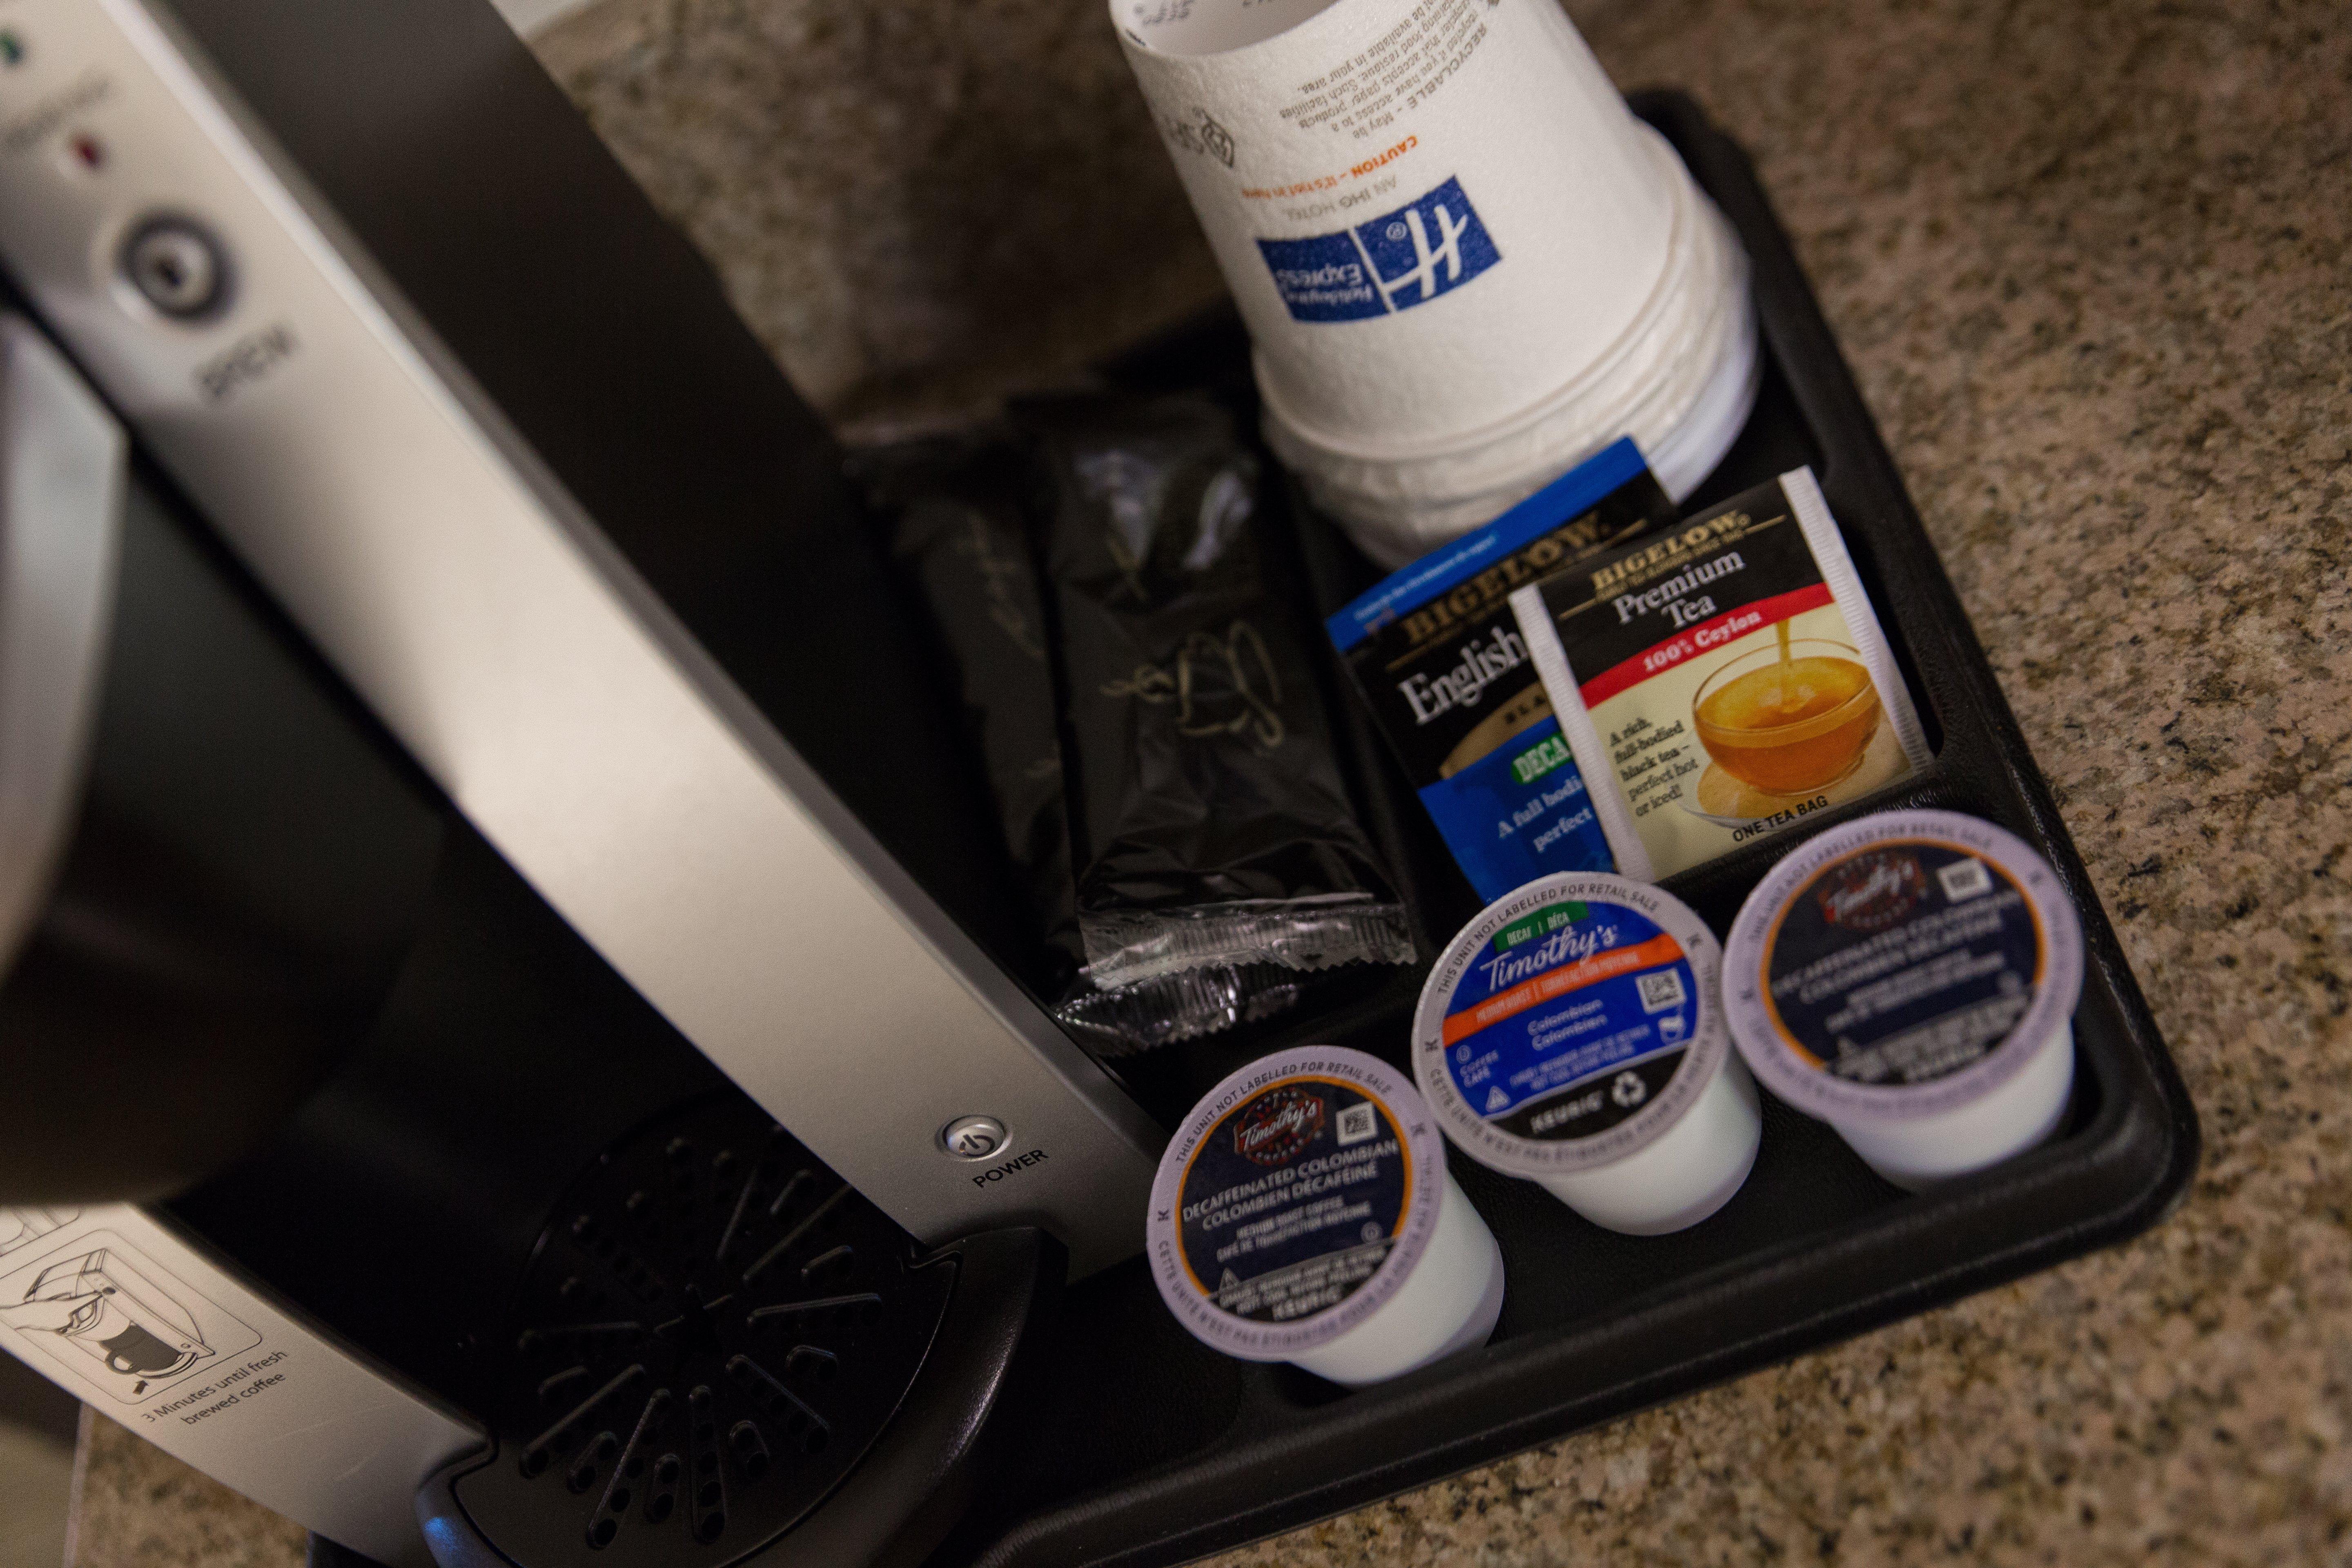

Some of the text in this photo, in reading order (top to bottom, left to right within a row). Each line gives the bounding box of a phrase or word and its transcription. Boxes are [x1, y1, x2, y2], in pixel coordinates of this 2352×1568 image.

[1412, 6, 1425, 20] be
[1368, 18, 1412, 58] available
[1329, 60, 1354, 82] your
[1355, 53, 1367, 66] in
[1407, 22, 1488, 109] RECYCLABLE
[1297, 77, 1327, 94] area.
[1329, 79, 1358, 100] Such
[1395, 74, 1421, 96] have
[1298, 100, 1347, 128] products
[1331, 122, 1339, 132] a
[1342, 115, 1355, 128] to
[1355, 94, 1394, 120] access
[1369, 111, 1394, 130] May
[1352, 126, 1369, 138] be
[1350, 135, 1418, 178] CAUTION
[1340, 187, 1371, 208] IHG
[1276, 262, 1363, 289] Express
[1592, 510, 1738, 590] BIGELOW
[1401, 510, 1599, 644] BIGELOW
[1613, 552, 1746, 624] Premium
[1661, 596, 1716, 628] Tea
[1644, 612, 1762, 672] 100% Ceylon
[1397, 626, 1528, 726] English
[1512, 736, 1571, 783] DECA
[1610, 732, 1621, 747] A
[1615, 719, 1685, 764] full-bodied
[1619, 757, 1657, 782] black
[1658, 748, 1681, 763] tea
[1628, 758, 1698, 802] perfect hot
[1499, 775, 1584, 838] A full bodi
[1635, 802, 1649, 816] or
[1733, 795, 1828, 841] ONE TEA BAG
[1533, 808, 1592, 853] perfect
[1437, 883, 1659, 993] THIS UNIT NOT LABELLED FOR RETAIL SALE
[1507, 926, 1532, 946] DECAF
[1479, 924, 1613, 991] Timothy's
[1528, 999, 1604, 1036] Colombian
[1532, 1014, 1608, 1051] Colombien
[1176, 1137, 1195, 1162] THIS
[1194, 1111, 1216, 1136] UNIT
[1217, 1092, 1239, 1113] NOT
[1240, 1064, 1297, 1094] LABELLED
[1301, 1062, 1323, 1073] FOR
[1327, 1062, 1363, 1080] RETAIL
[1240, 1100, 1316, 1152] Timothy's
[1530, 1091, 1603, 1134] KEURIG
[972, 1149, 1049, 1188] POWER
[1183, 1167, 1296, 1223] DECAFFEINATED
[1298, 1139, 1399, 1179] COLOMBIAN
[1203, 1186, 1290, 1231] COLOMBIEN
[1158, 1241, 1177, 1281] CETTE
[141, 1350, 288, 1423] 3 Minutes until fresh
[180, 1373, 287, 1424] brewed coffee
